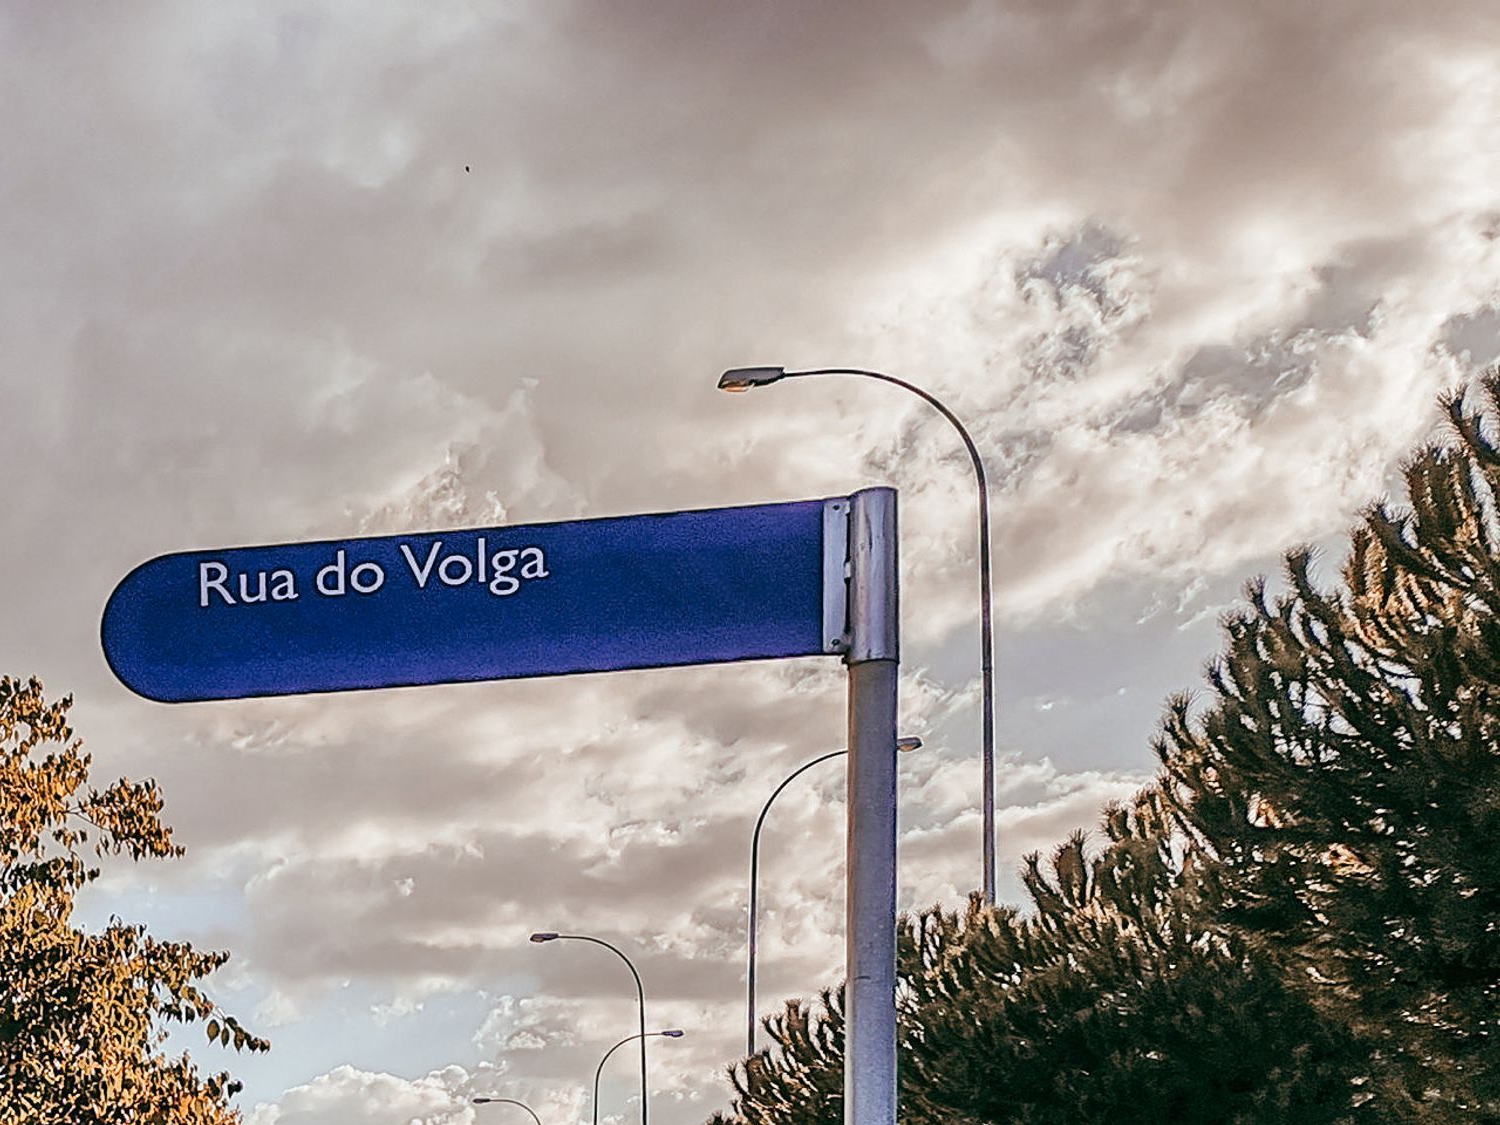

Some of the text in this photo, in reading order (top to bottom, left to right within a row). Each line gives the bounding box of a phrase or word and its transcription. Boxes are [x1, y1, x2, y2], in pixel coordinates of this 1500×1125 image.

[199, 537, 550, 607] Rua do Volga
